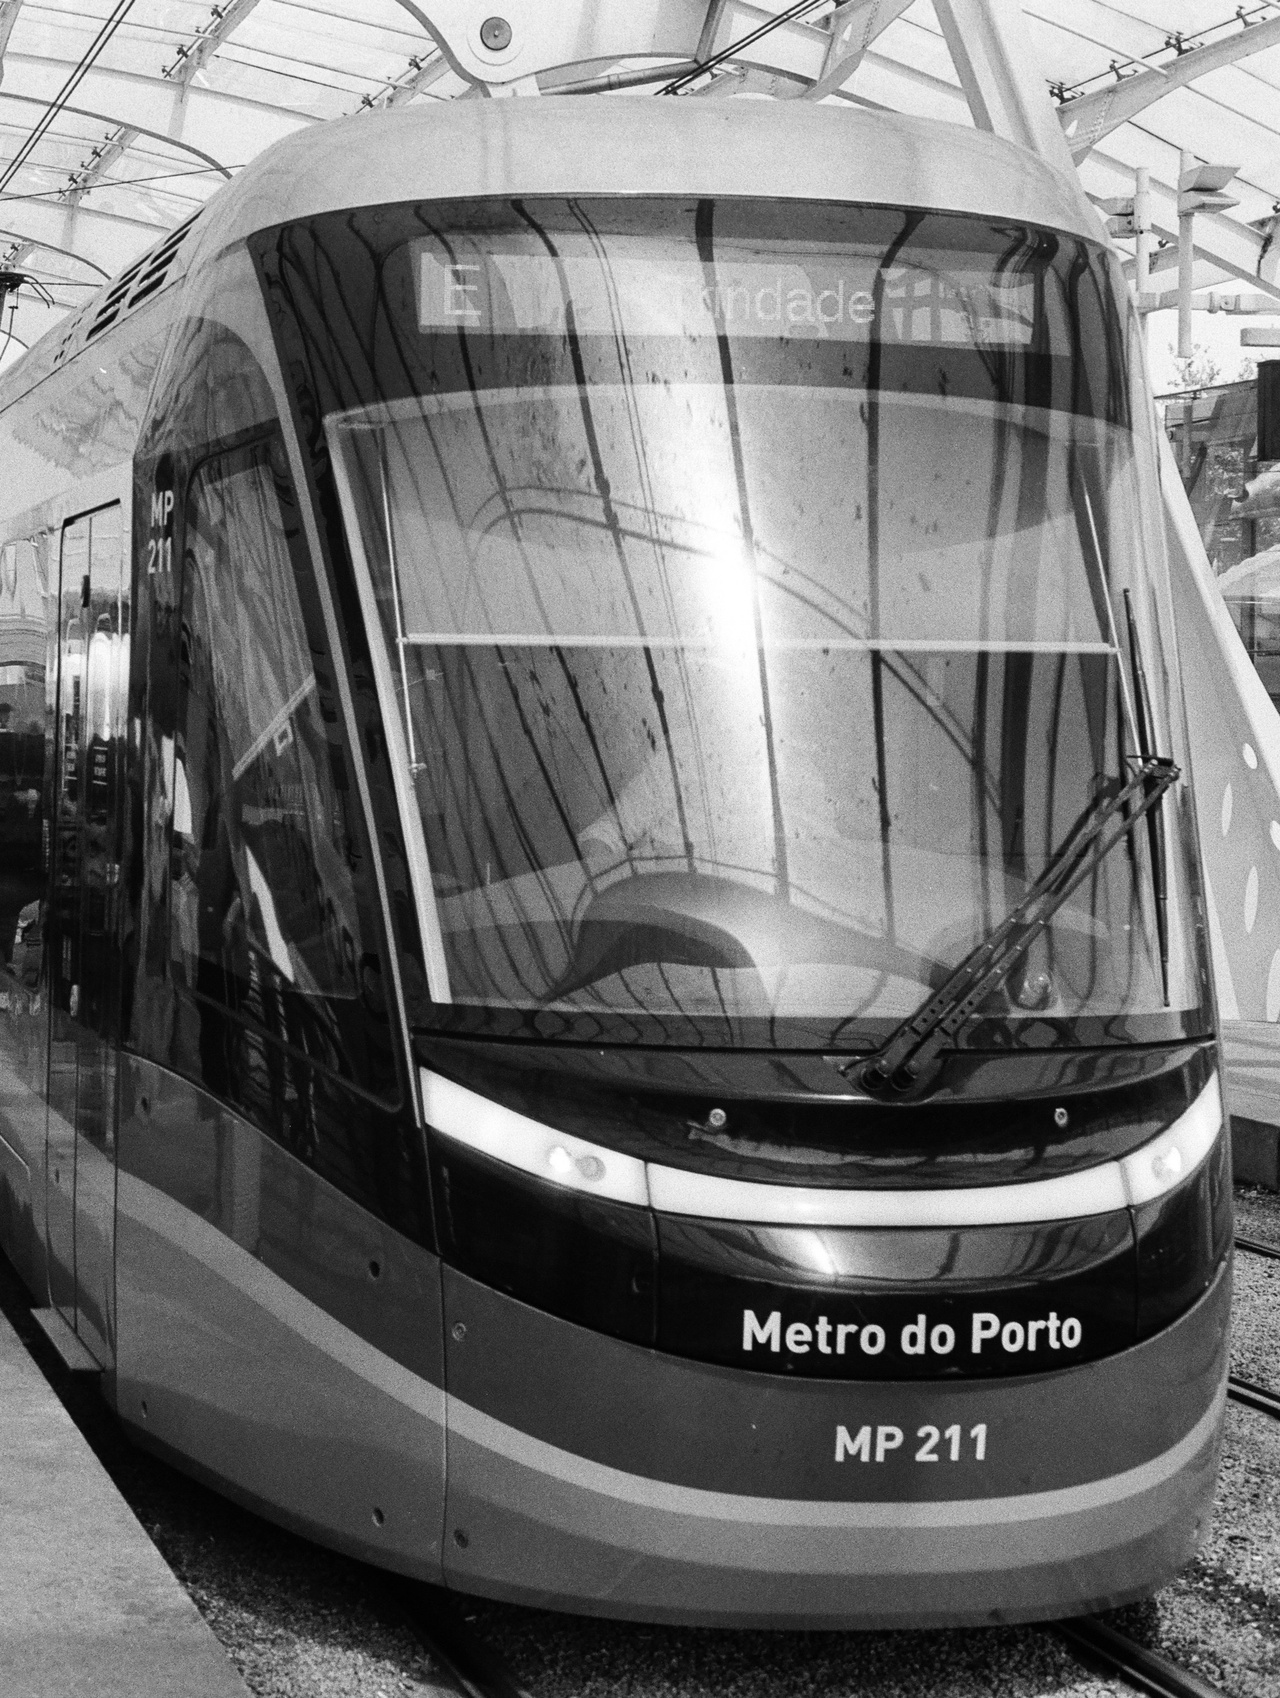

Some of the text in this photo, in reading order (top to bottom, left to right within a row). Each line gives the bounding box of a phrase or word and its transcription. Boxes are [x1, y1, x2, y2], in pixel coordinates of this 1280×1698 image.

[444, 264, 482, 316] E
[150, 490, 174, 527] MP
[147, 537, 172, 574] 211
[742, 1309, 1082, 1355] Metro do Porto
[834, 1423, 988, 1463] MP 211
